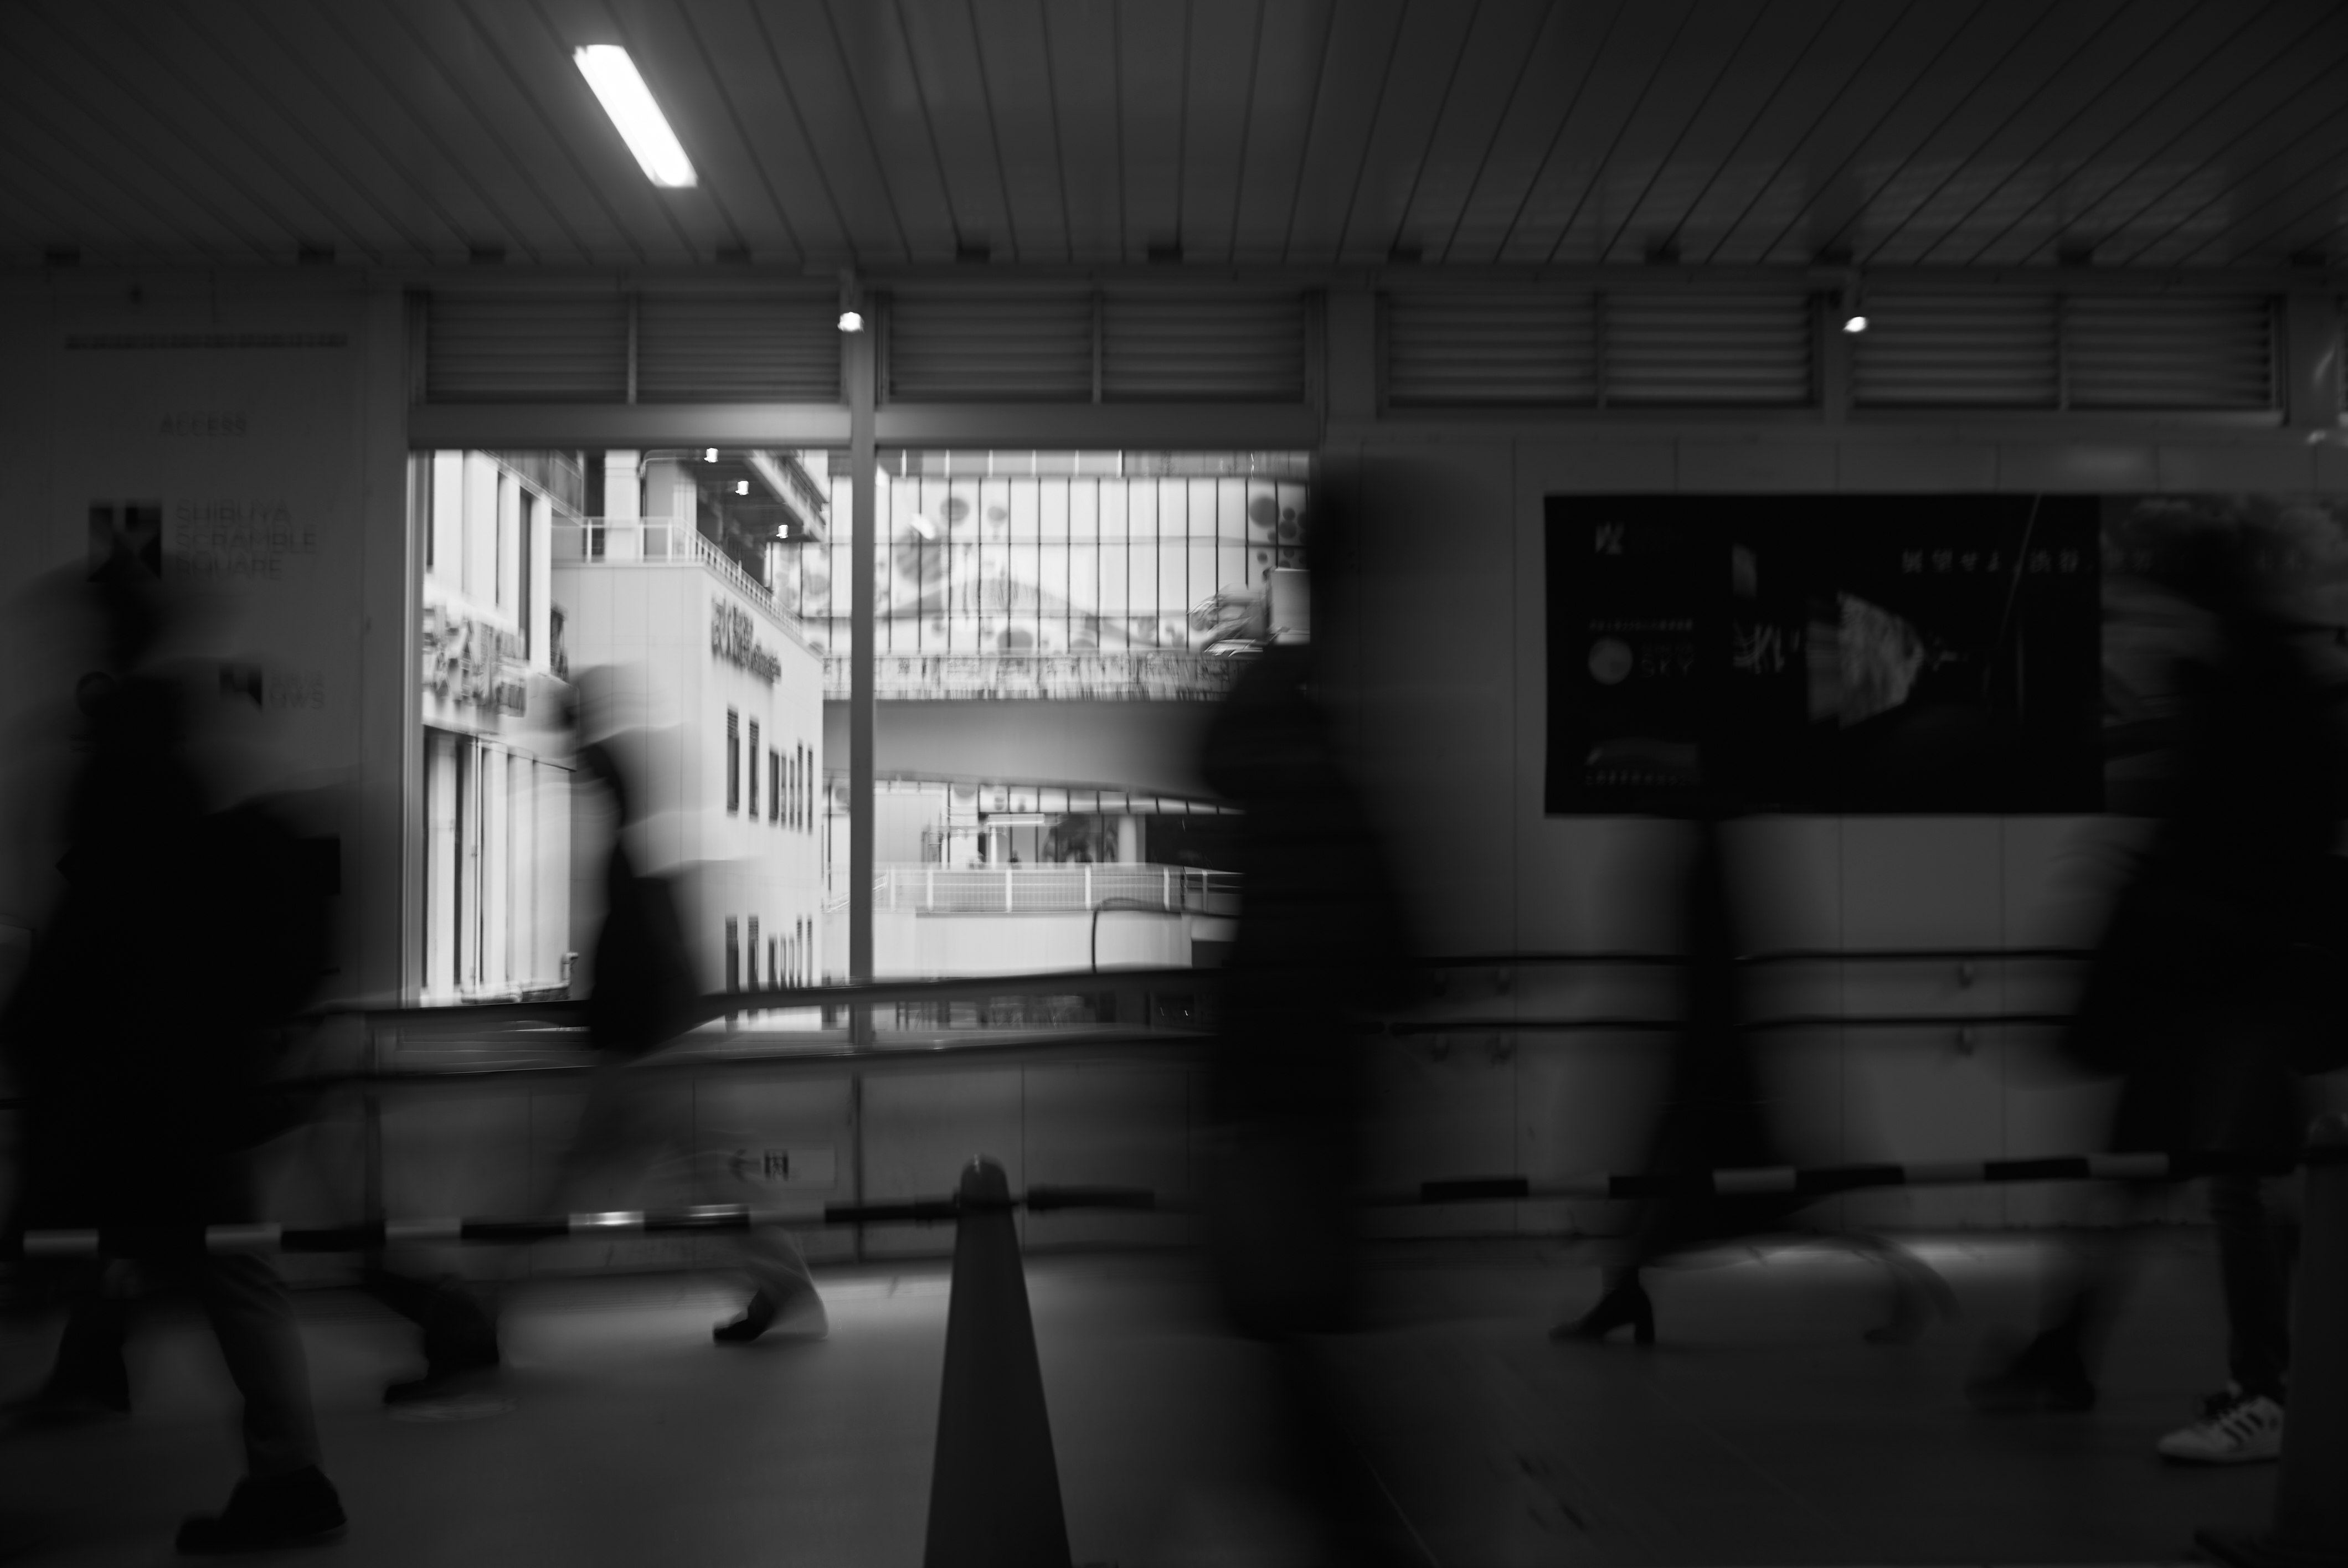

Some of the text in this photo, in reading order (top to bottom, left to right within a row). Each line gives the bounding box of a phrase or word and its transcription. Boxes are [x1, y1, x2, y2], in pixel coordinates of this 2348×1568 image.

[159, 410, 247, 437] ACCESS
[176, 499, 292, 527] SHIBUYA
[176, 523, 316, 554] SCRAMBLE
[176, 551, 282, 580] SQUARE
